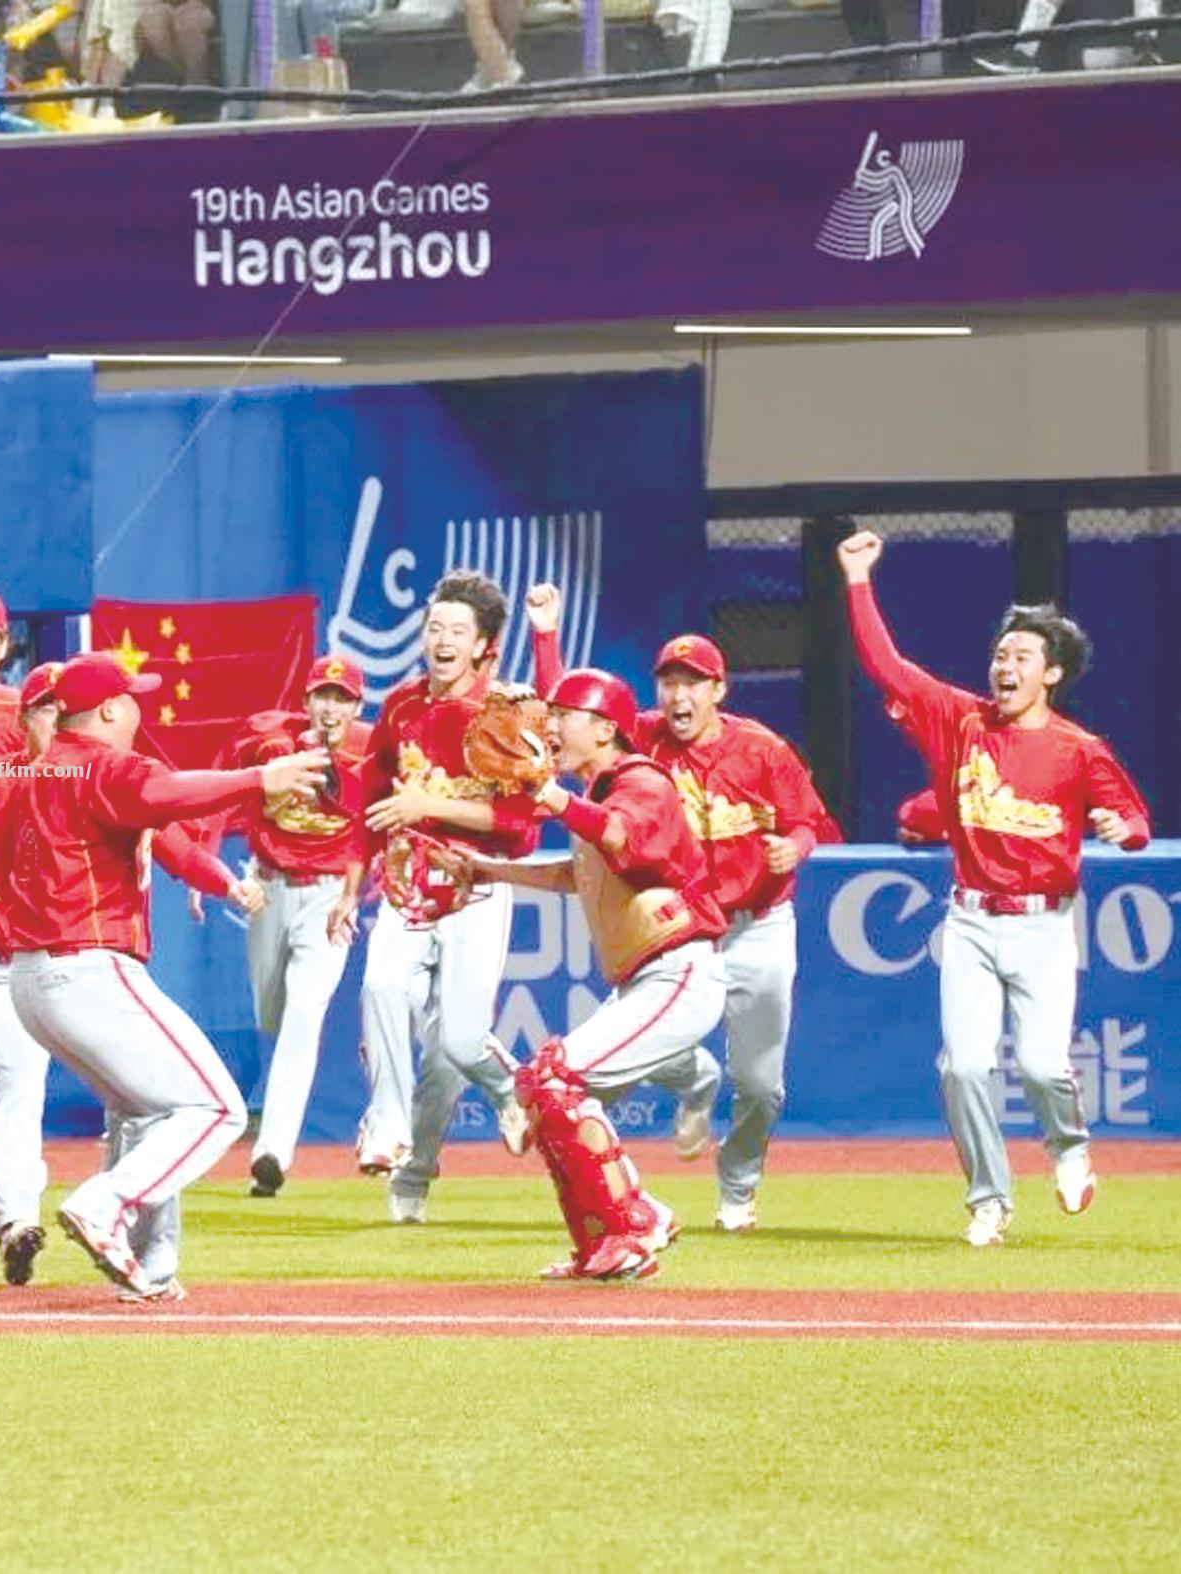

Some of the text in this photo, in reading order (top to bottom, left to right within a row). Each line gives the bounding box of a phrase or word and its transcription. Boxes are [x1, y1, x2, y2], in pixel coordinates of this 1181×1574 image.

[191, 180, 491, 223] 19th Asian Games
[193, 221, 492, 296] Hangzhou
